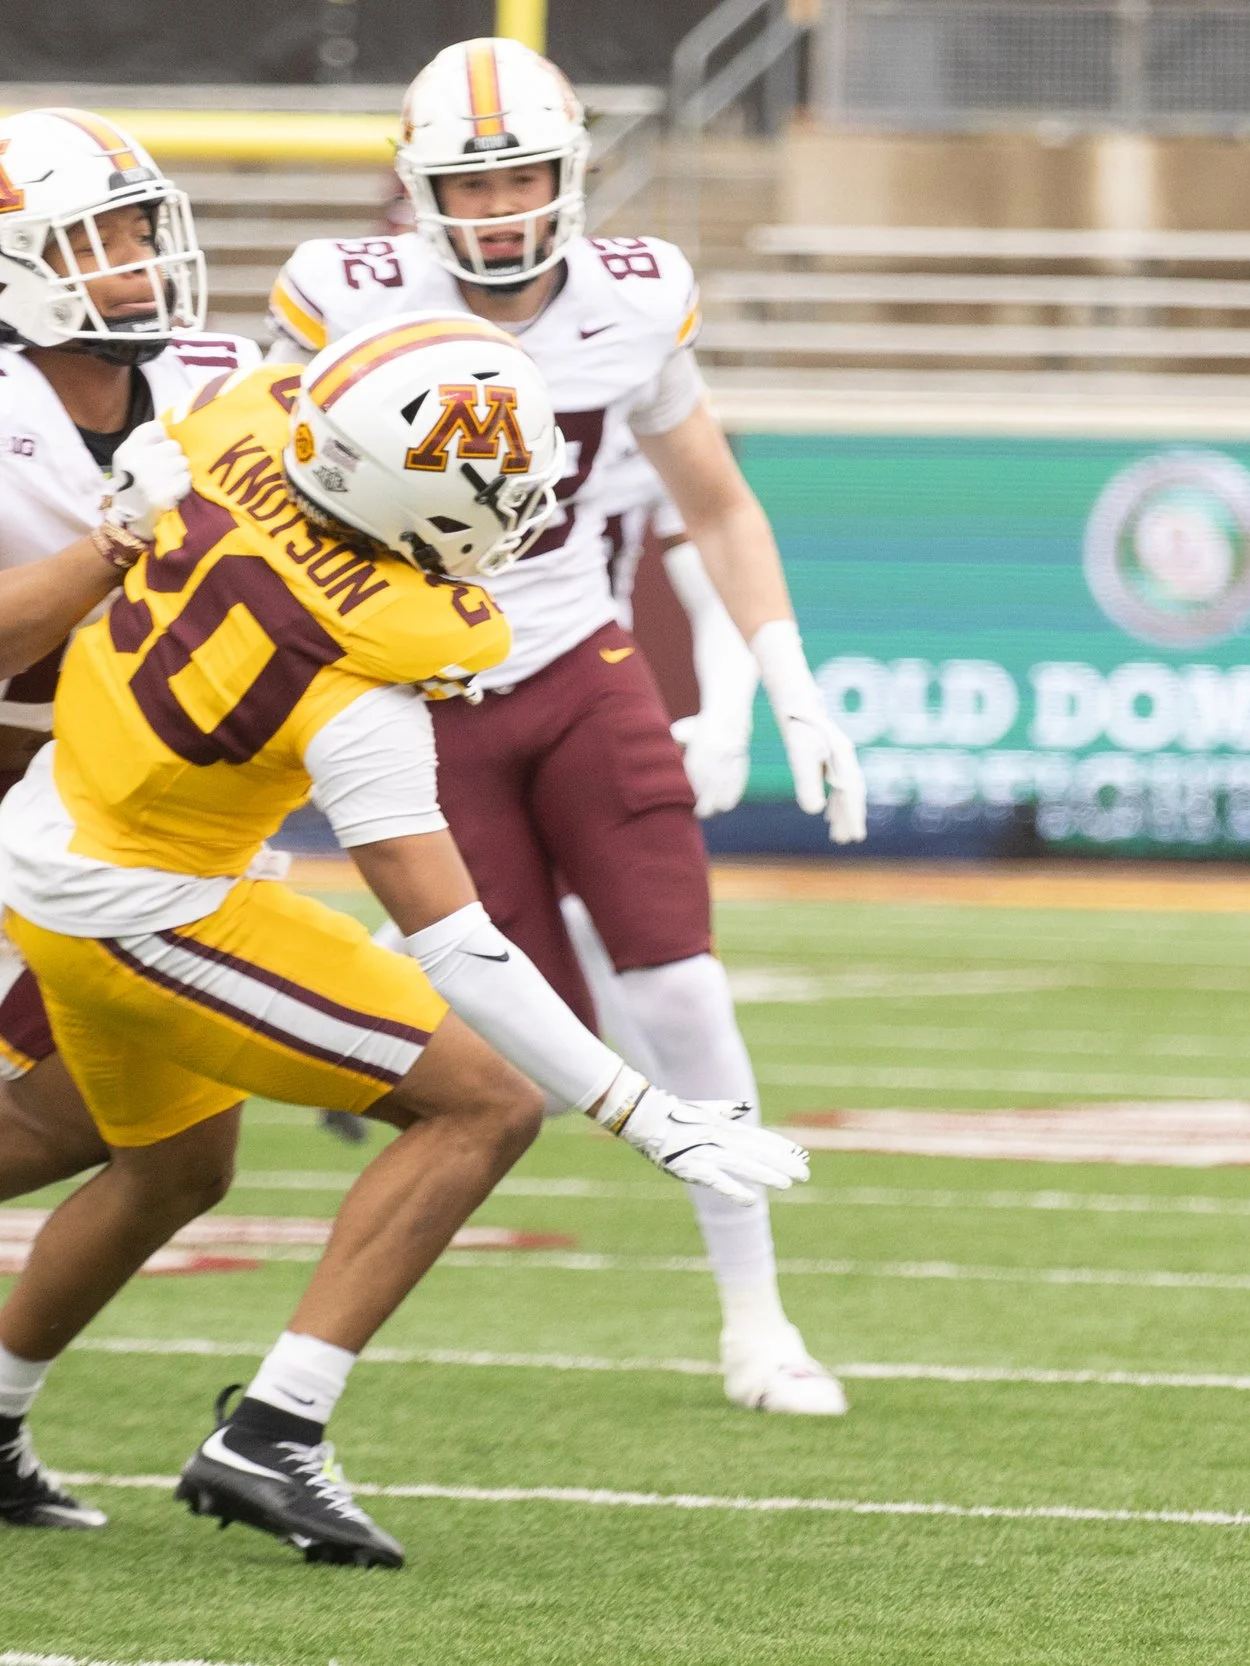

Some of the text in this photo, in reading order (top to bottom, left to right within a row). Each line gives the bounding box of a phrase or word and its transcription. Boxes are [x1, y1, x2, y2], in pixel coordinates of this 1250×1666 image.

[404, 383, 533, 474] M
[109, 488, 348, 767] 20
[814, 655, 1019, 748] OLD
